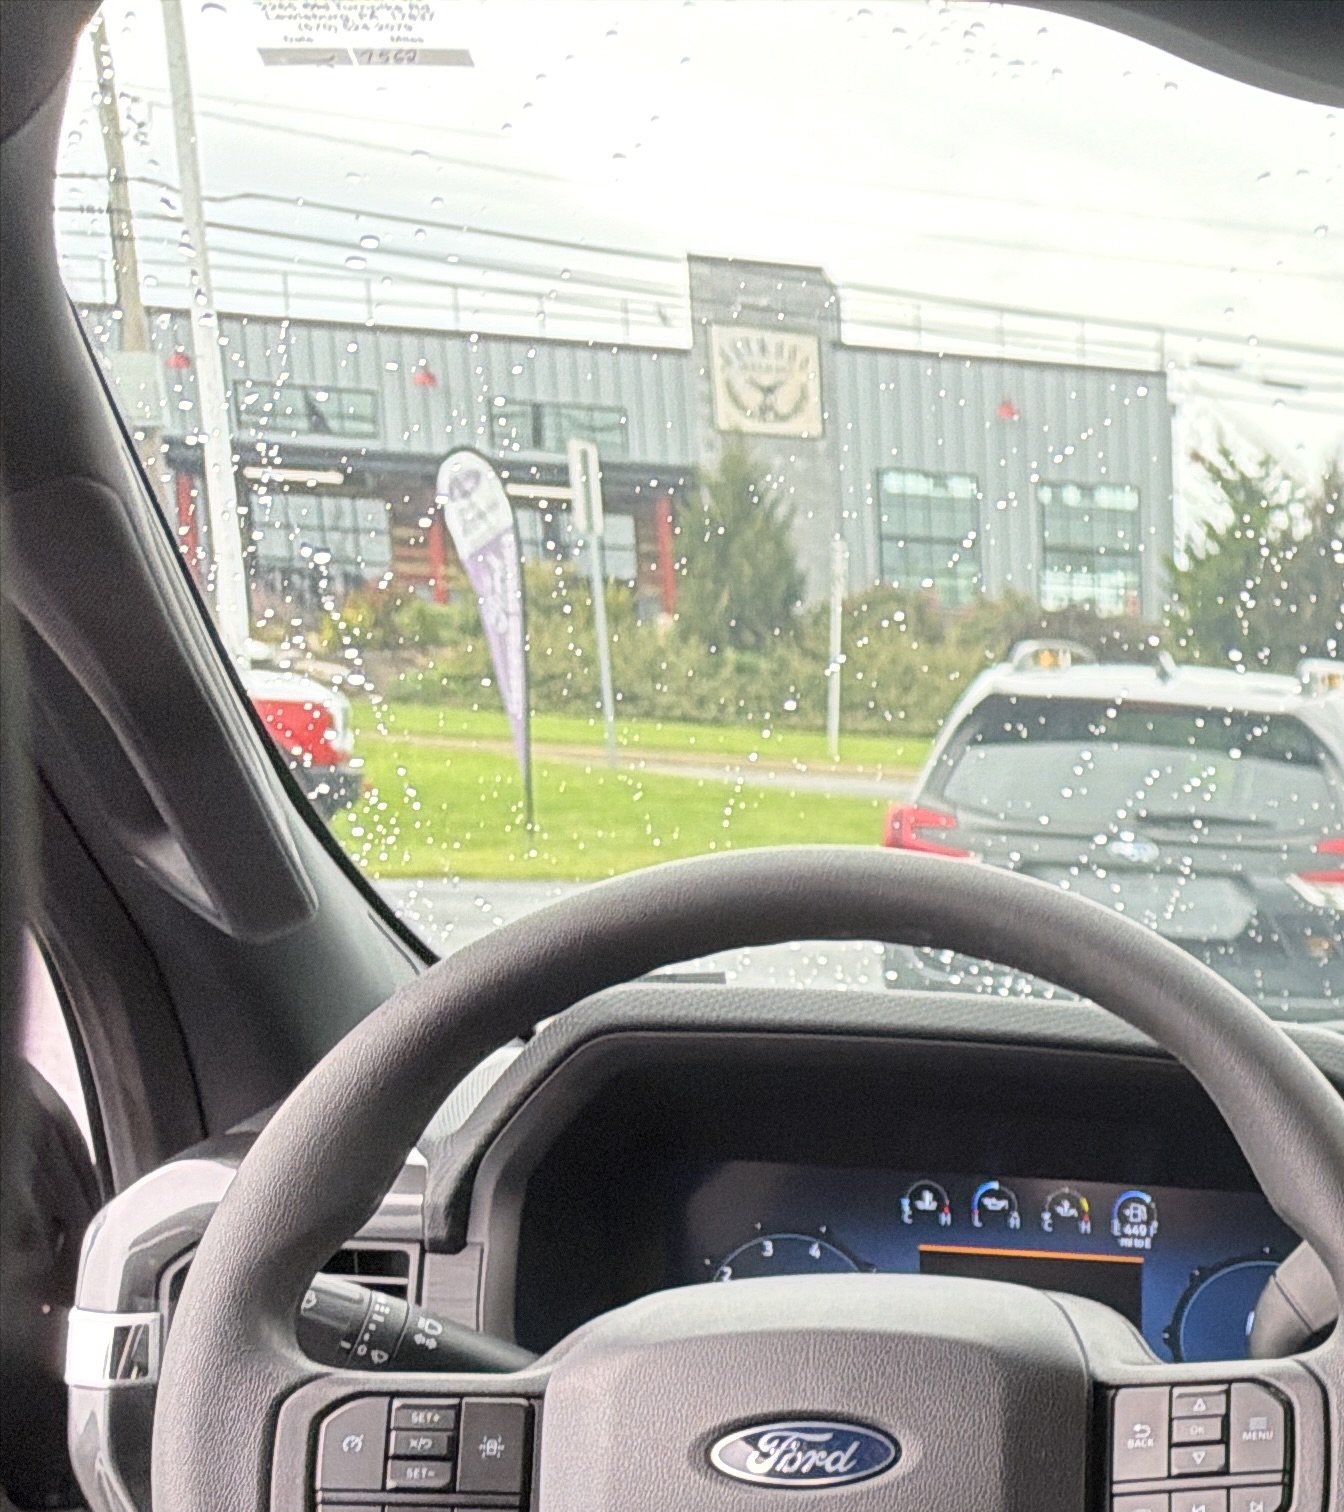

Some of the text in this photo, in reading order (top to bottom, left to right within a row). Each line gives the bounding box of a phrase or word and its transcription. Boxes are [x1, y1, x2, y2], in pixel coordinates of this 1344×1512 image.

[762, 1240, 774, 1257] 3
[1242, 1430, 1274, 1441] MENU
[1127, 1438, 1154, 1449] BACK
[746, 1430, 861, 1474] Ford
